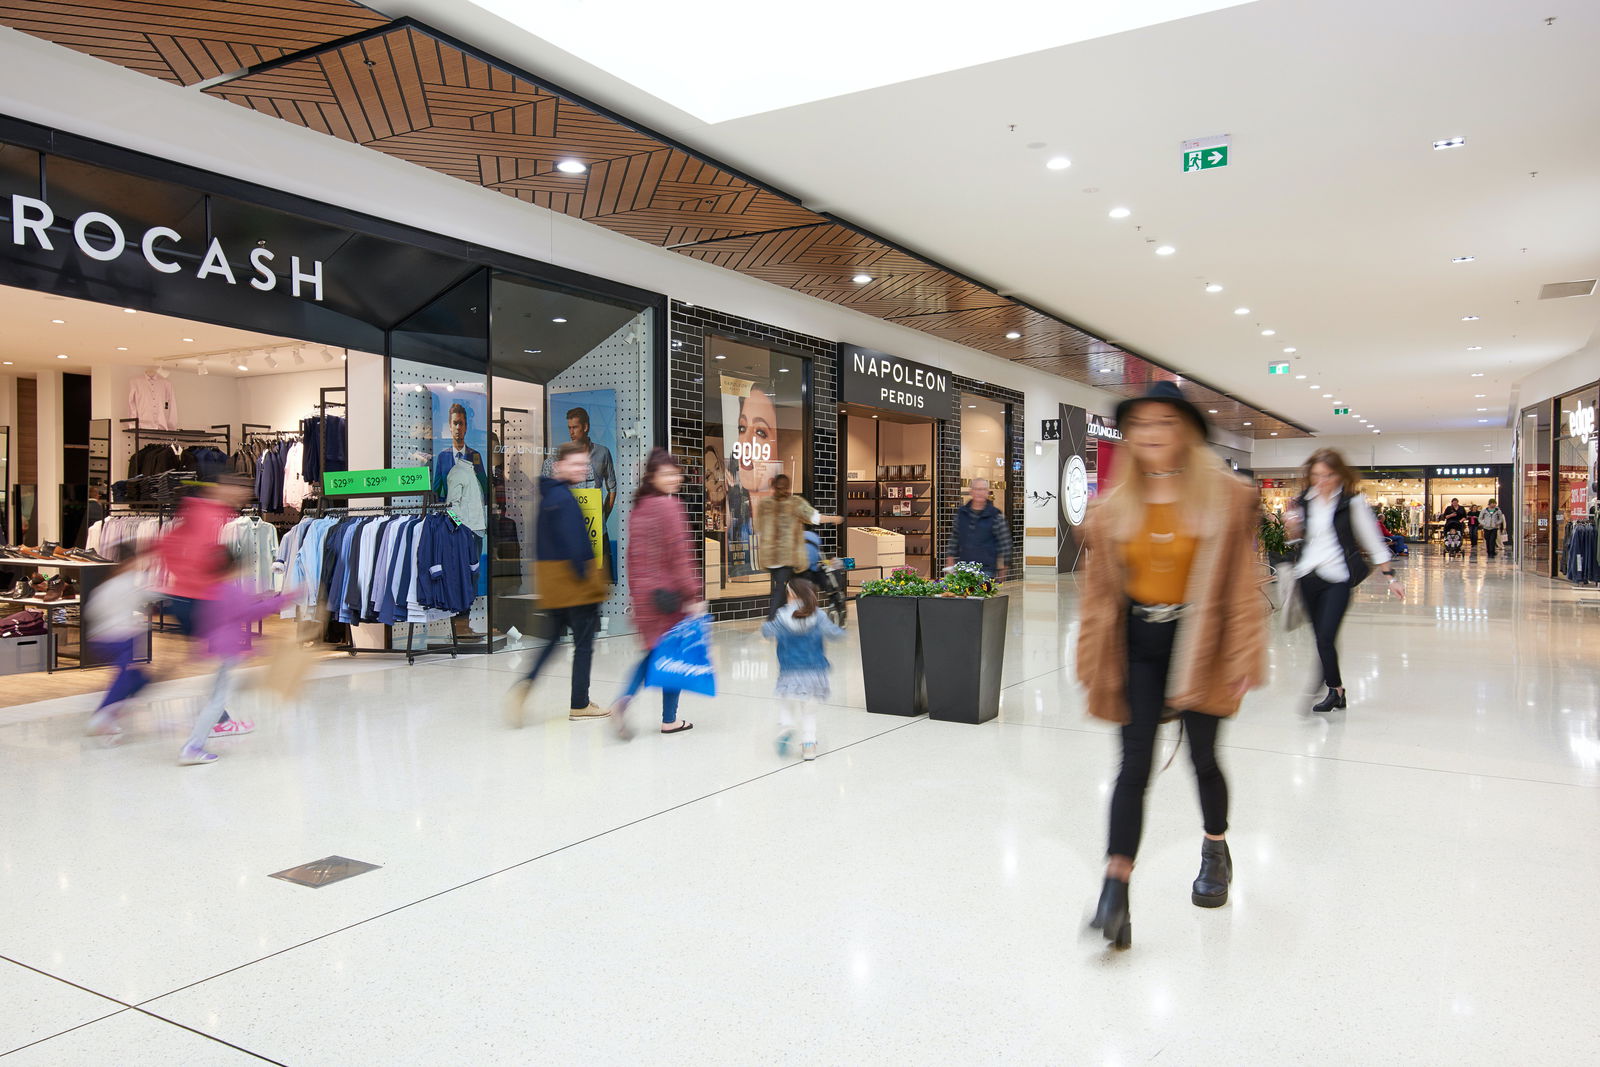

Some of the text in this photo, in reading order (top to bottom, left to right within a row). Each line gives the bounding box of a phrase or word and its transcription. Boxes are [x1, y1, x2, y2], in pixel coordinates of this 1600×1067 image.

[853, 353, 946, 392] NAPOLEON
[880, 387, 924, 408] PERDIS
[1569, 400, 1595, 444] edge
